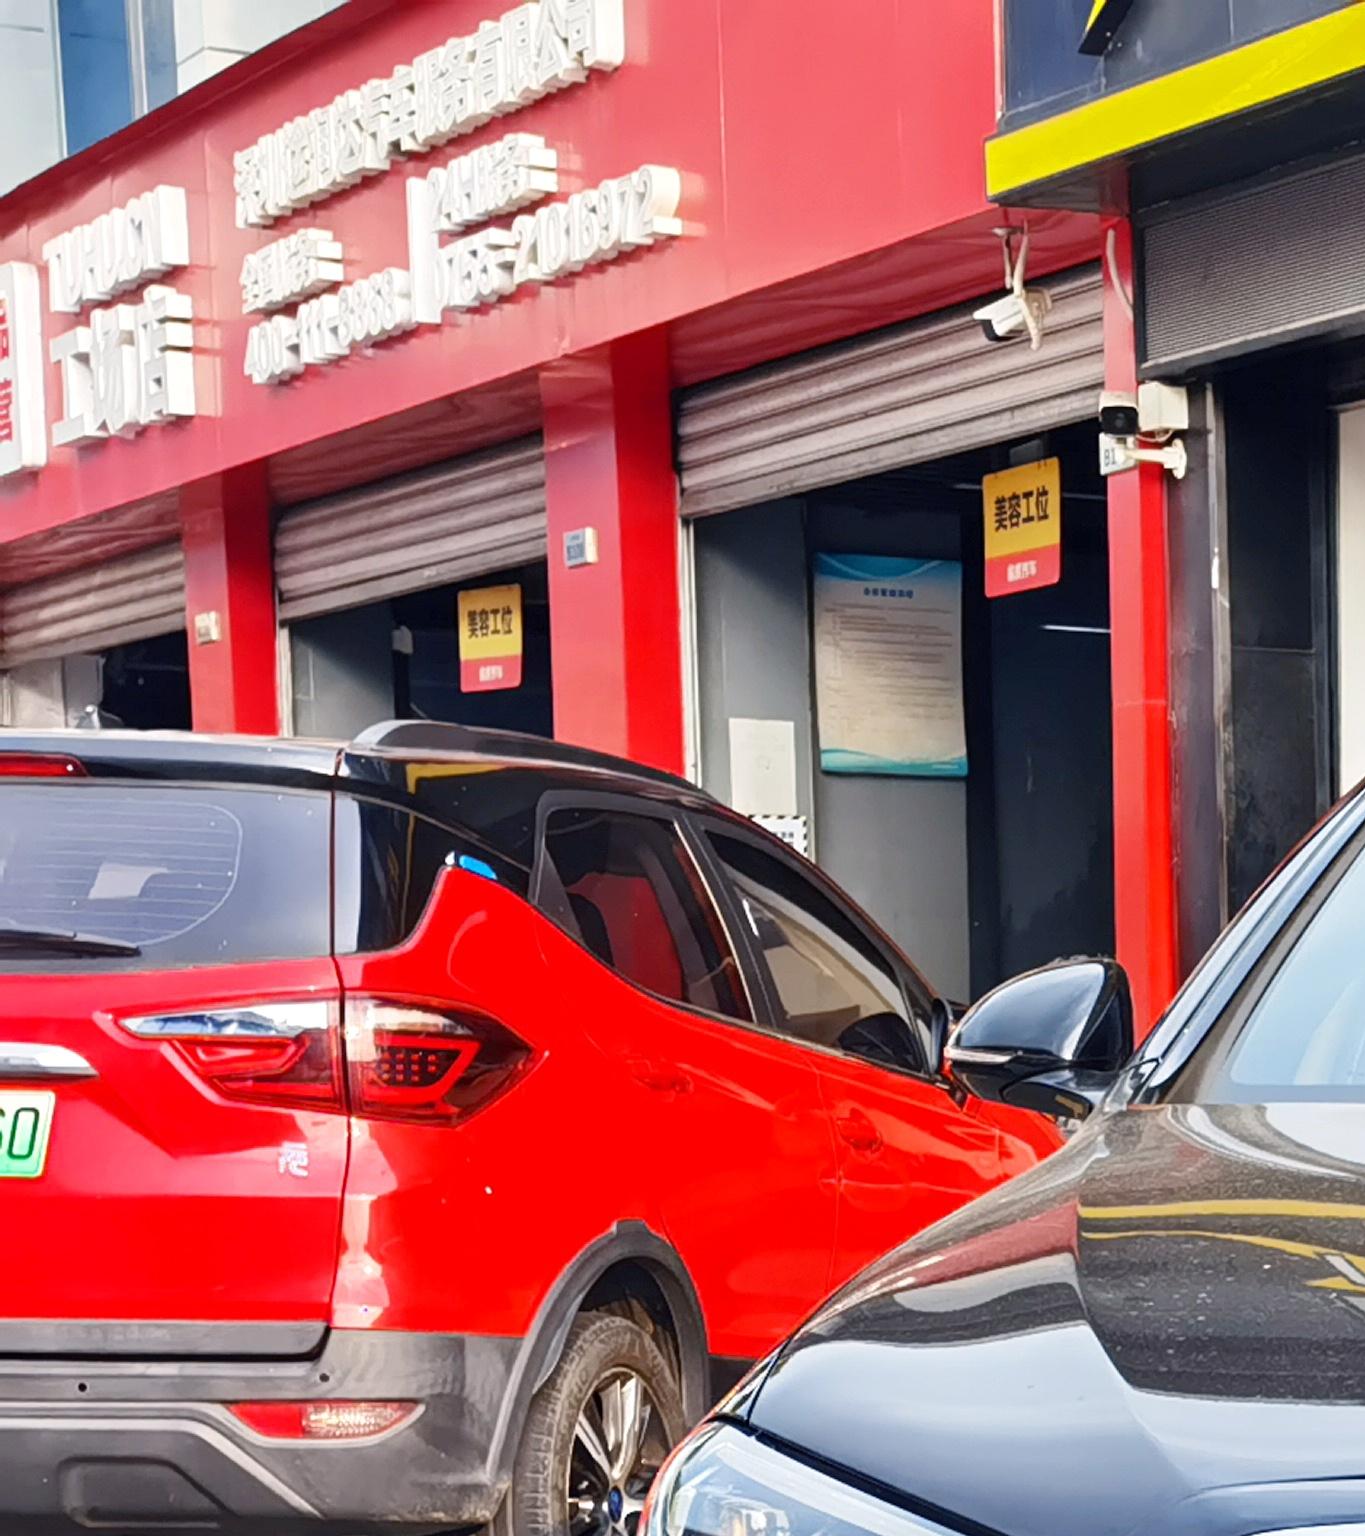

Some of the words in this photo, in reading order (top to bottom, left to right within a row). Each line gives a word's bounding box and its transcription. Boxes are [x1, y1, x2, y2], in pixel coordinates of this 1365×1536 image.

[433, 164, 682, 308] 0755-21016972
[994, 486, 1049, 532] 美容工位
[467, 606, 513, 639] 美容工位
